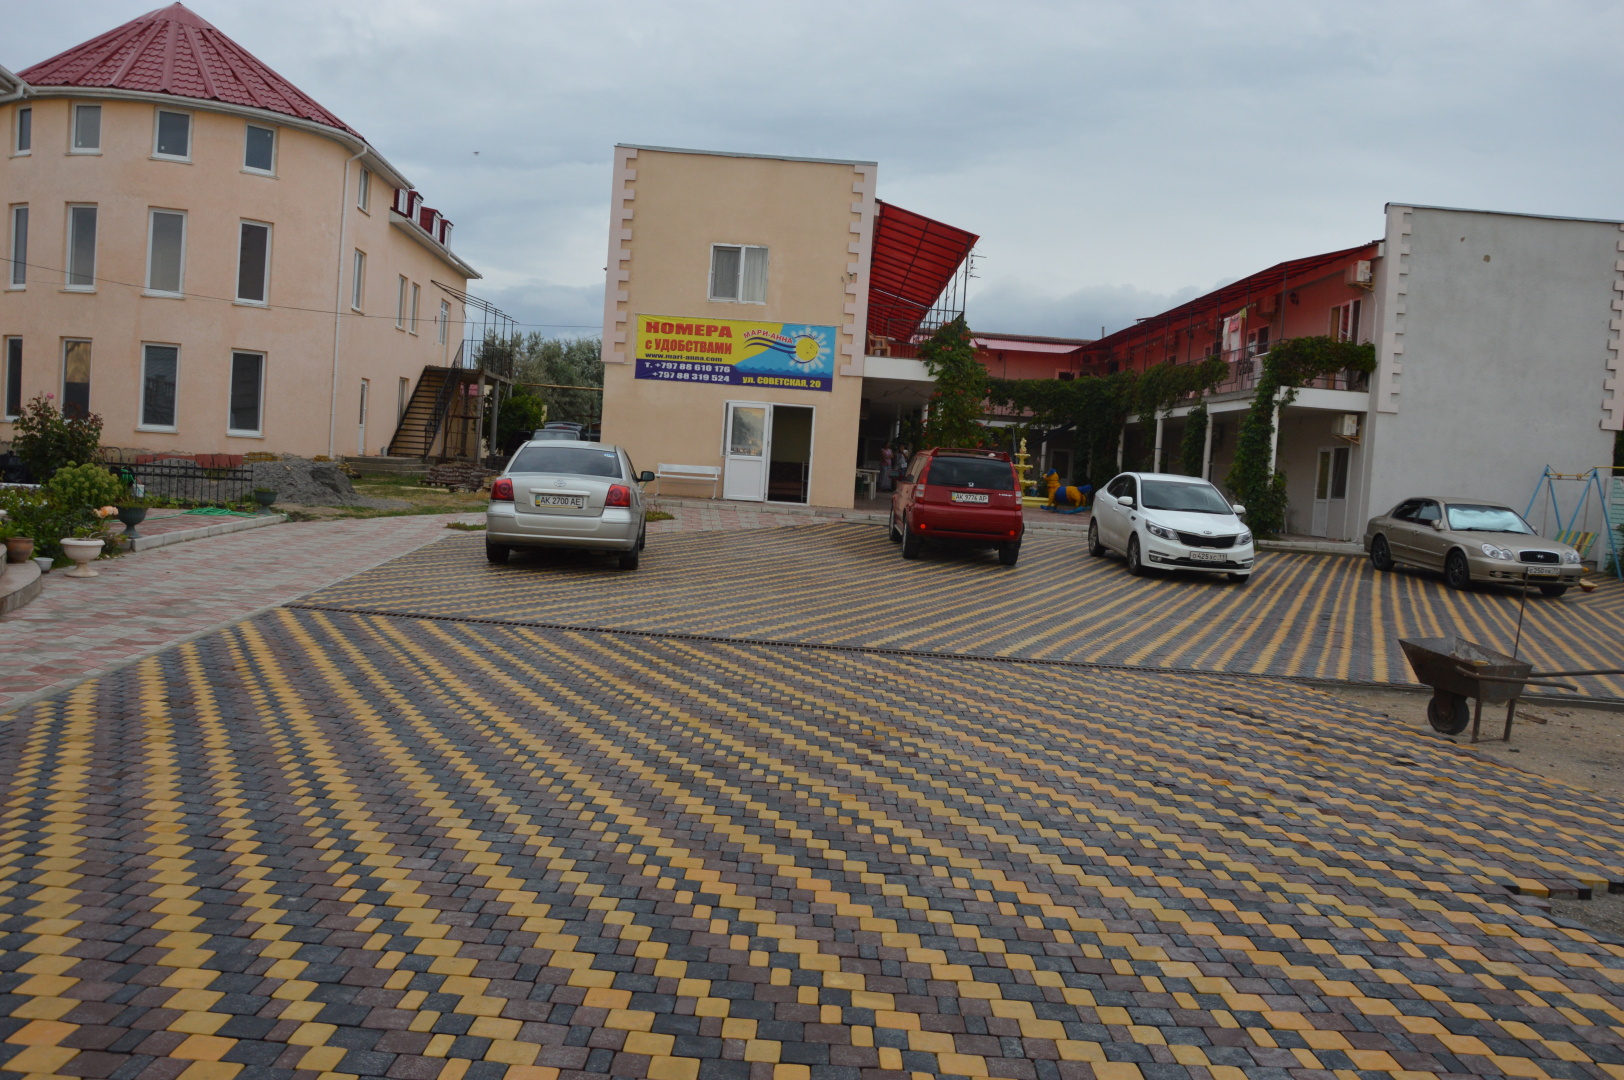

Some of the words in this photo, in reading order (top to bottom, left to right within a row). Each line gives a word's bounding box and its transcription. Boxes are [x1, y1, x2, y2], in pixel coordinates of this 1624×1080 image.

[645, 321, 733, 338] НОМЕРА
[743, 329, 793, 344] МАРИ-АННА
[654, 338, 733, 355] УДОБСТВАМИ
[645, 353, 723, 362] www.mari-anna.com
[655, 362, 678, 370] +797
[679, 363, 692, 371] 88
[694, 364, 712, 372] 610
[714, 365, 731, 373] 176
[652, 371, 675, 379] +797
[676, 372, 690, 380] 88
[691, 373, 710, 381] 319
[711, 374, 730, 382] 524
[756, 376, 808, 387] СОВЕТСКАЯ,
[809, 379, 821, 388] 20
[552, 497, 569, 505] 2700
